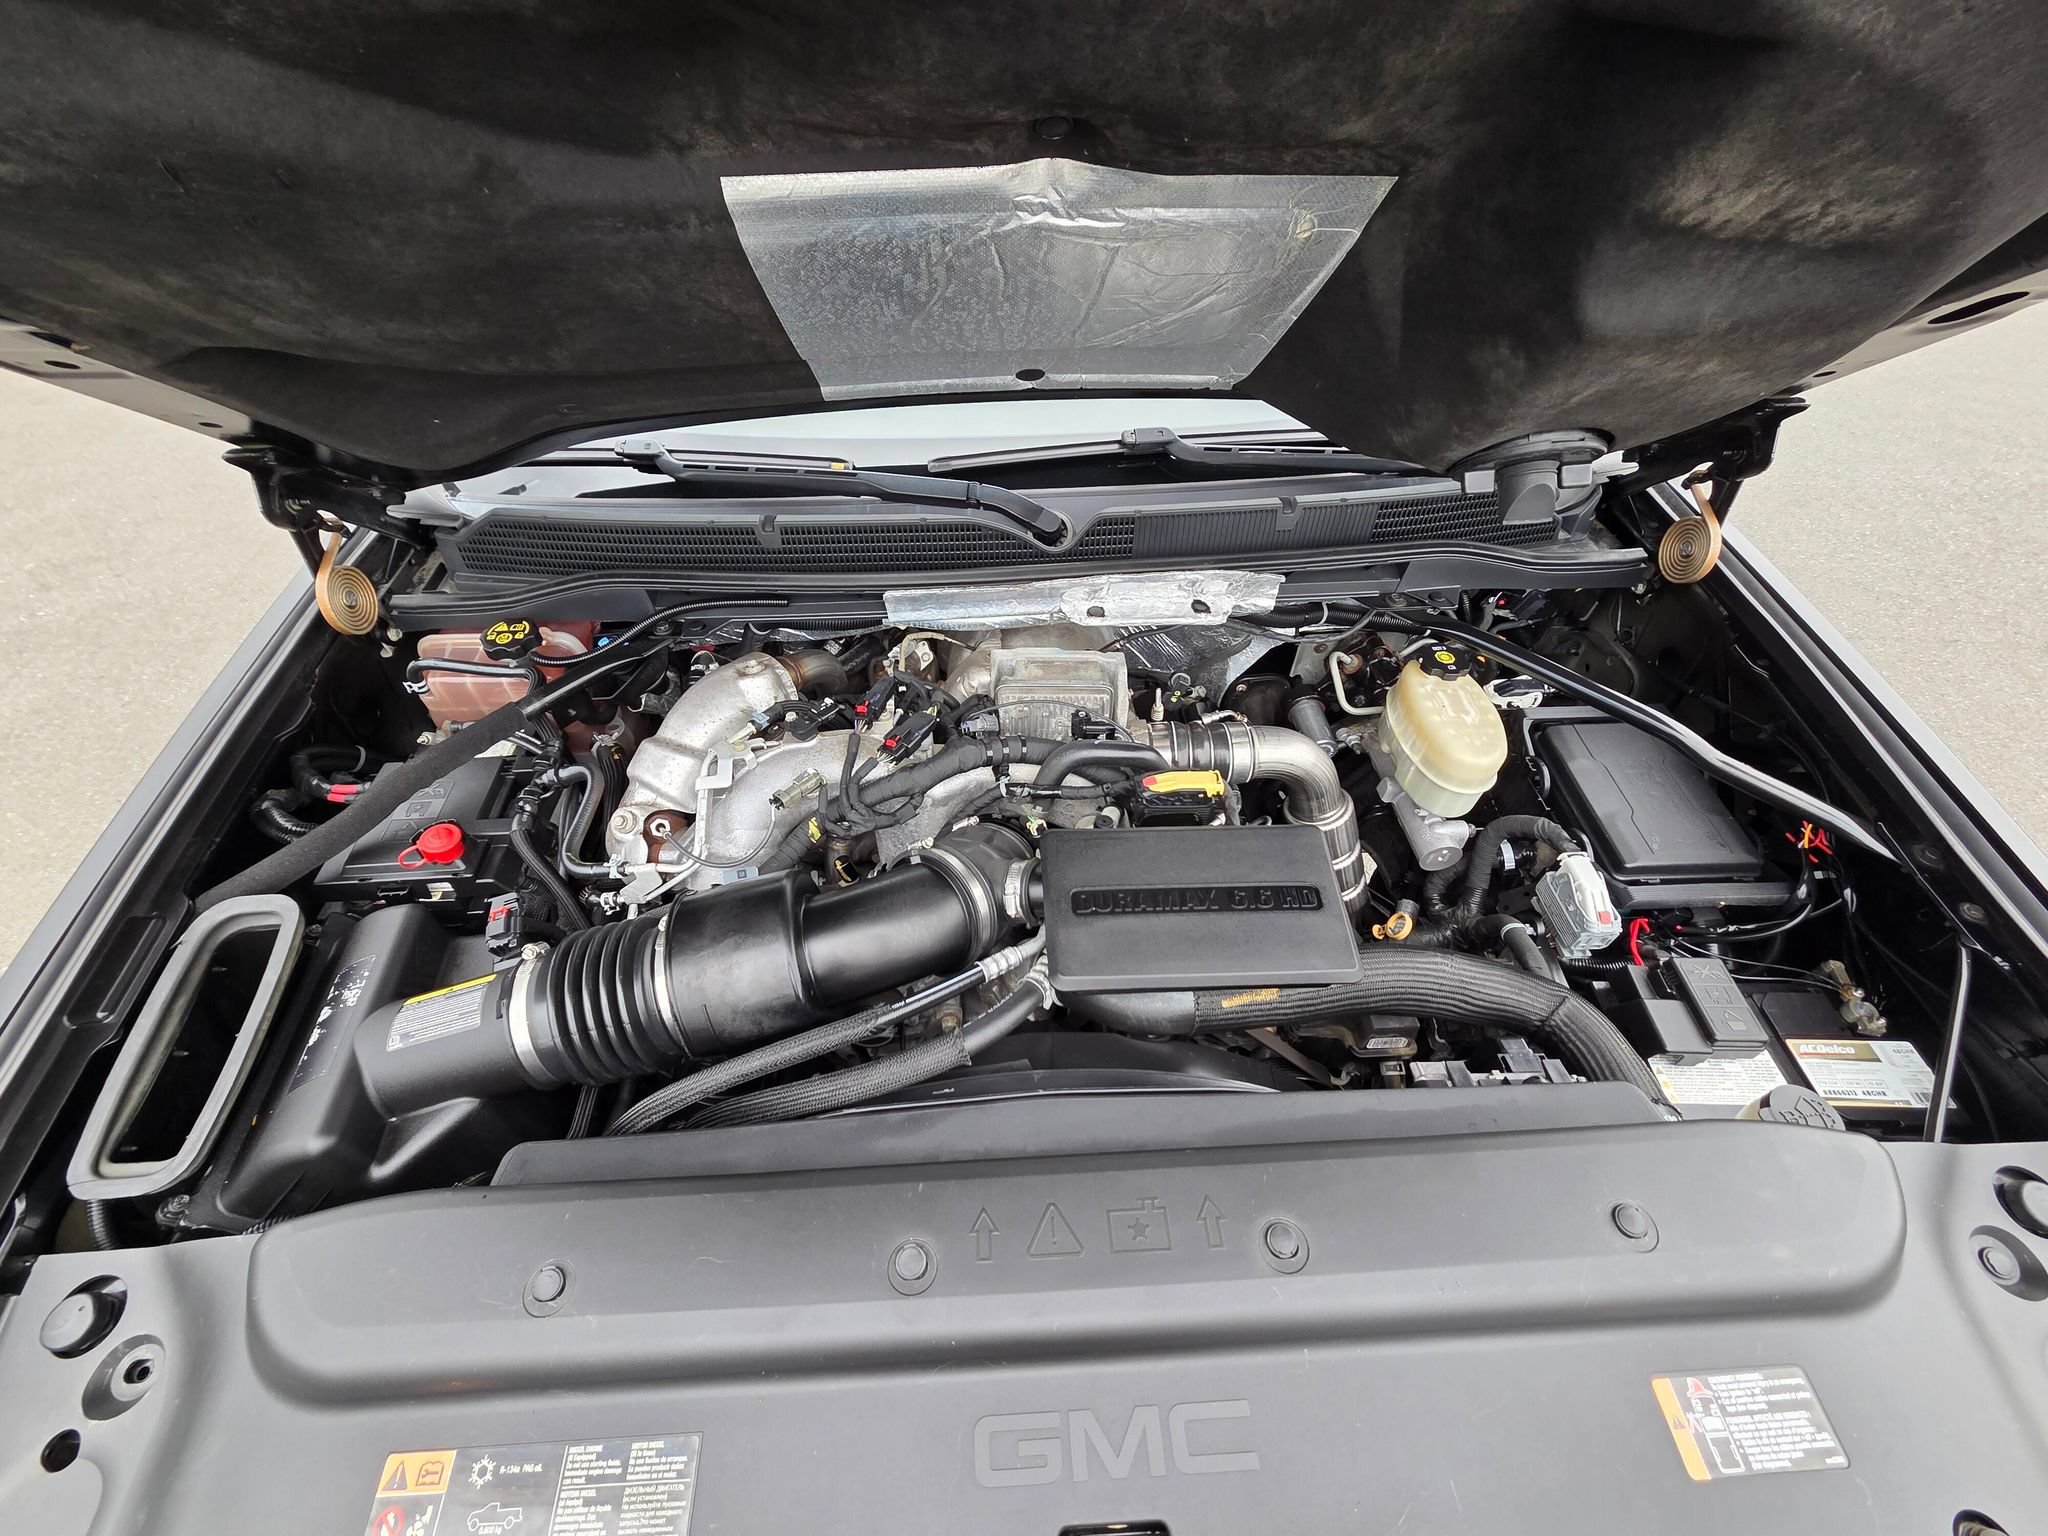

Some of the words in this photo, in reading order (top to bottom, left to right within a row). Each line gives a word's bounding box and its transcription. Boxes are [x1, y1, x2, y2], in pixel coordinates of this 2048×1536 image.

[1075, 889, 1219, 912] DURAMAX
[1231, 888, 1275, 910] 6.6
[1282, 887, 1320, 908] HD
[1799, 1043, 1856, 1055] ACDelco
[974, 1398, 1260, 1488] GMC
